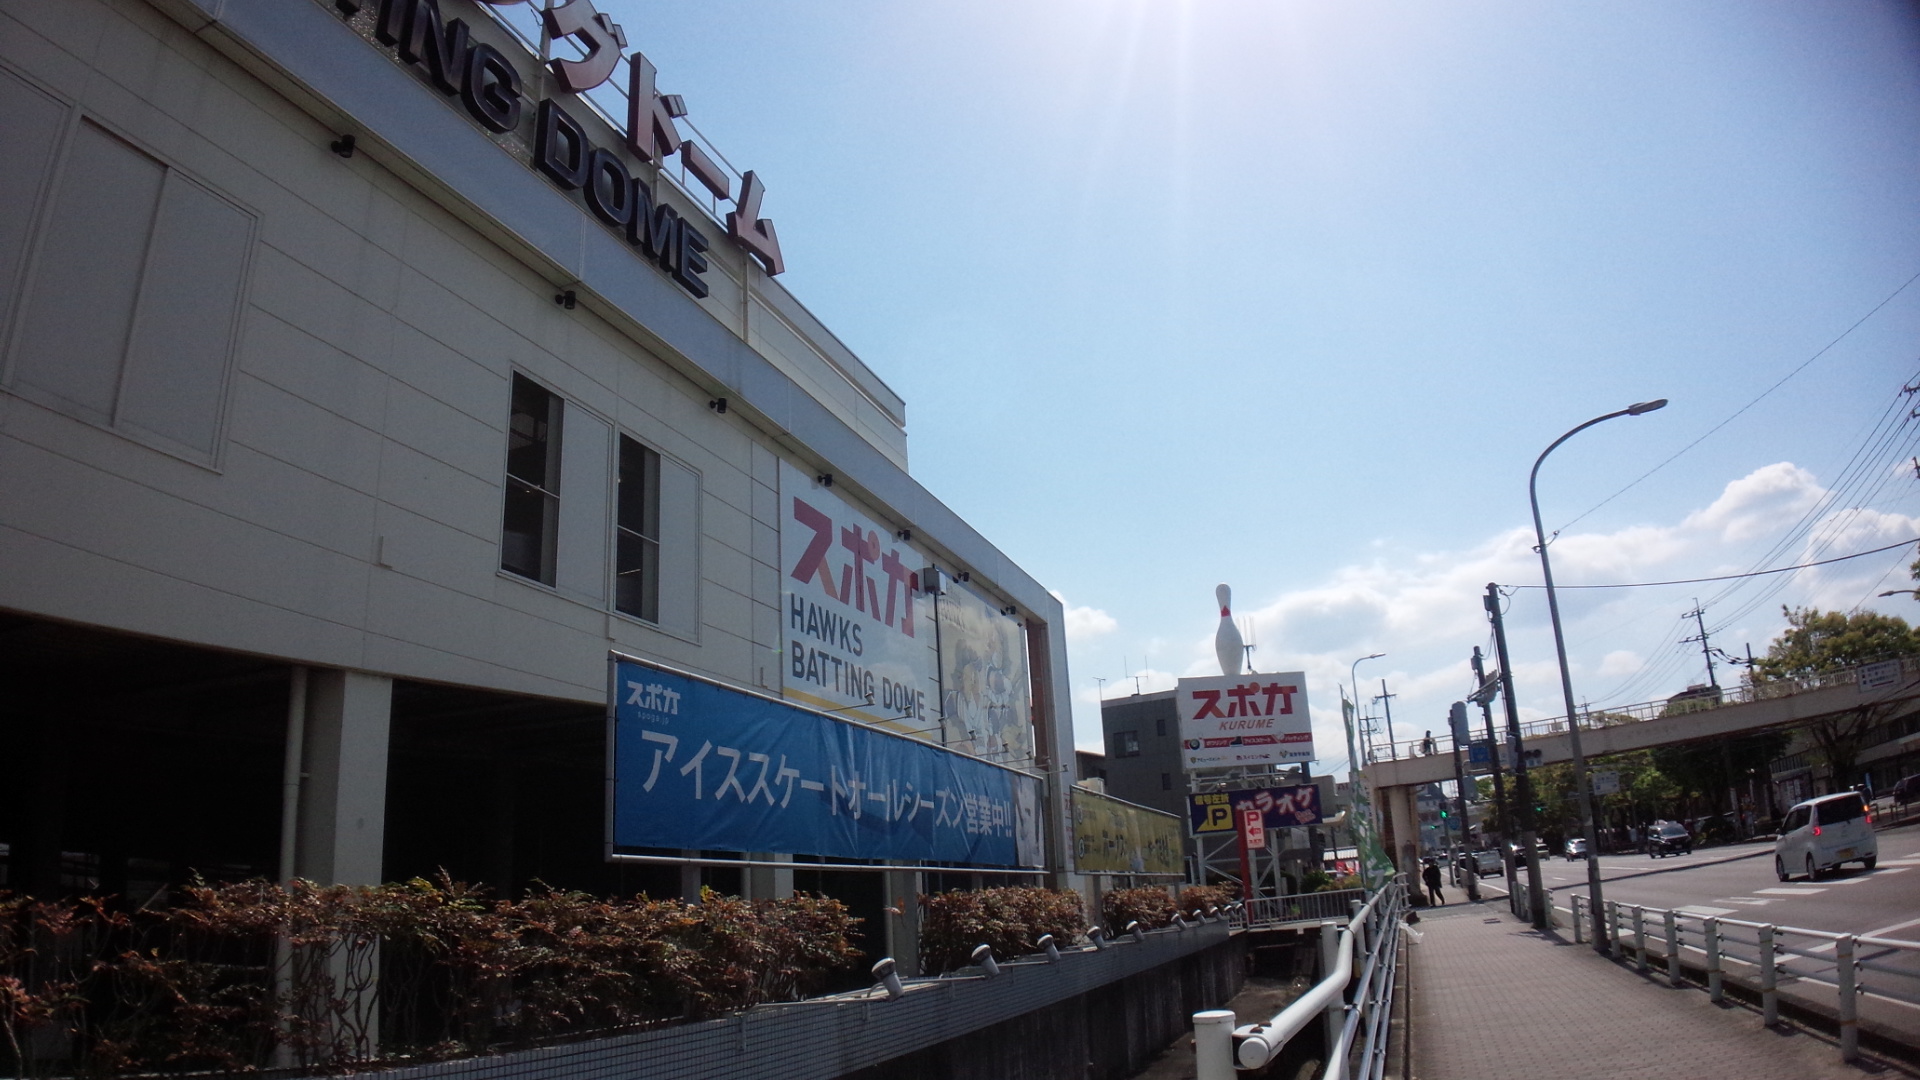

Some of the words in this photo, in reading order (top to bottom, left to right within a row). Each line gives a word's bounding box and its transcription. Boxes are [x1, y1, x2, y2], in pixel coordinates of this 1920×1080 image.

[333, 0, 523, 134] ING
[533, 98, 709, 299] DOME
[480, 0, 785, 277] グドーム
[790, 496, 919, 639] スポカ
[790, 593, 863, 657] HAWKS
[626, 680, 681, 715] スポカ
[791, 640, 875, 702] BATTING
[882, 676, 926, 722] DOME
[1192, 682, 1298, 720] スポカ
[1219, 718, 1275, 731] KURUME
[1211, 808, 1228, 826] P
[1246, 811, 1260, 826] P
